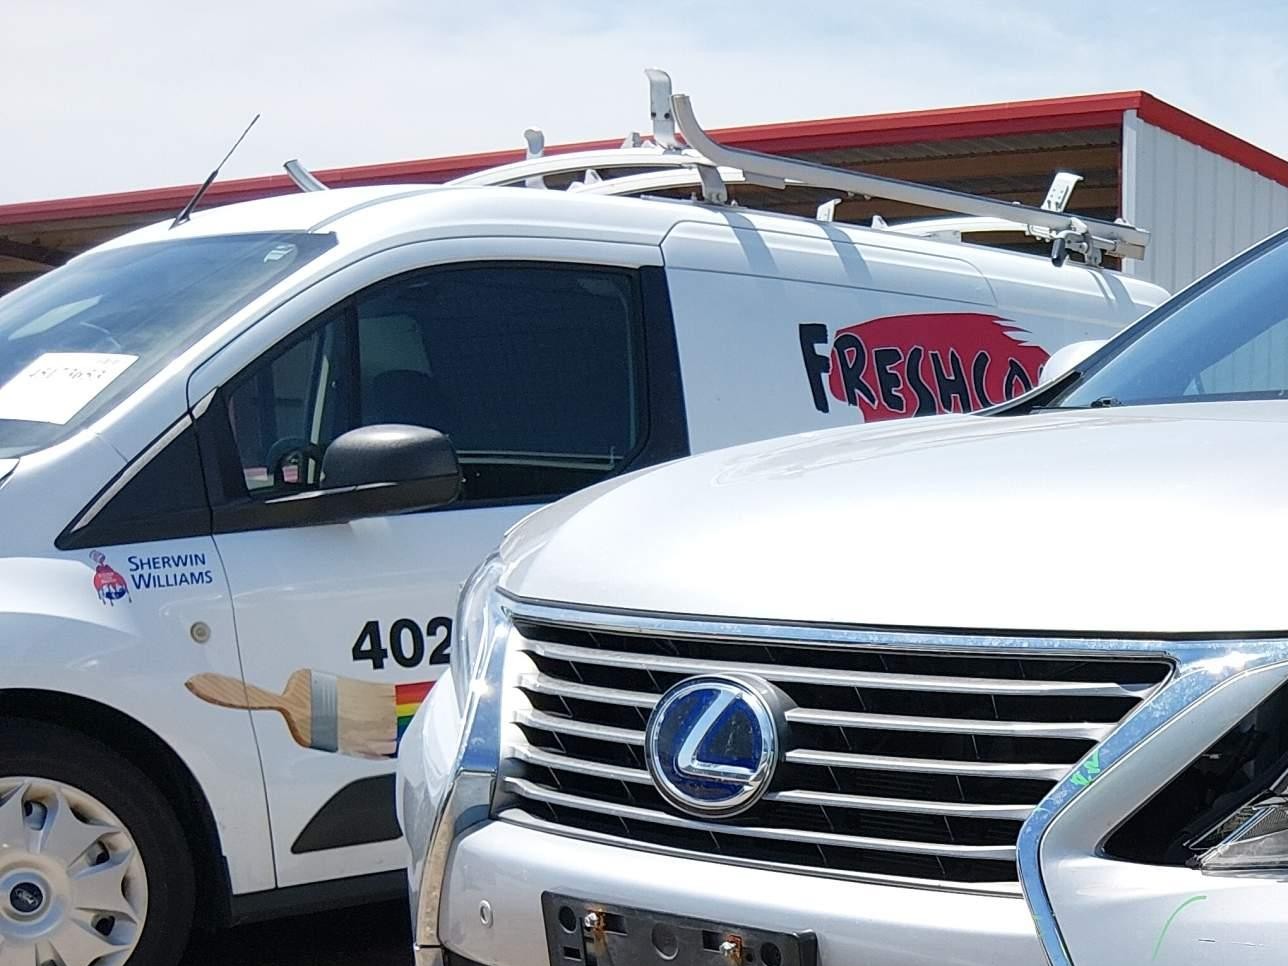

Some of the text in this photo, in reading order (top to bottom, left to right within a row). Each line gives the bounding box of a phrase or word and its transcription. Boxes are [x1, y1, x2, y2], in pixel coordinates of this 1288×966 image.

[798, 322, 1047, 418] FRESHCO
[127, 553, 206, 572] SHERWIN
[131, 570, 213, 590] WILLIAMS
[351, 616, 453, 670] 402
